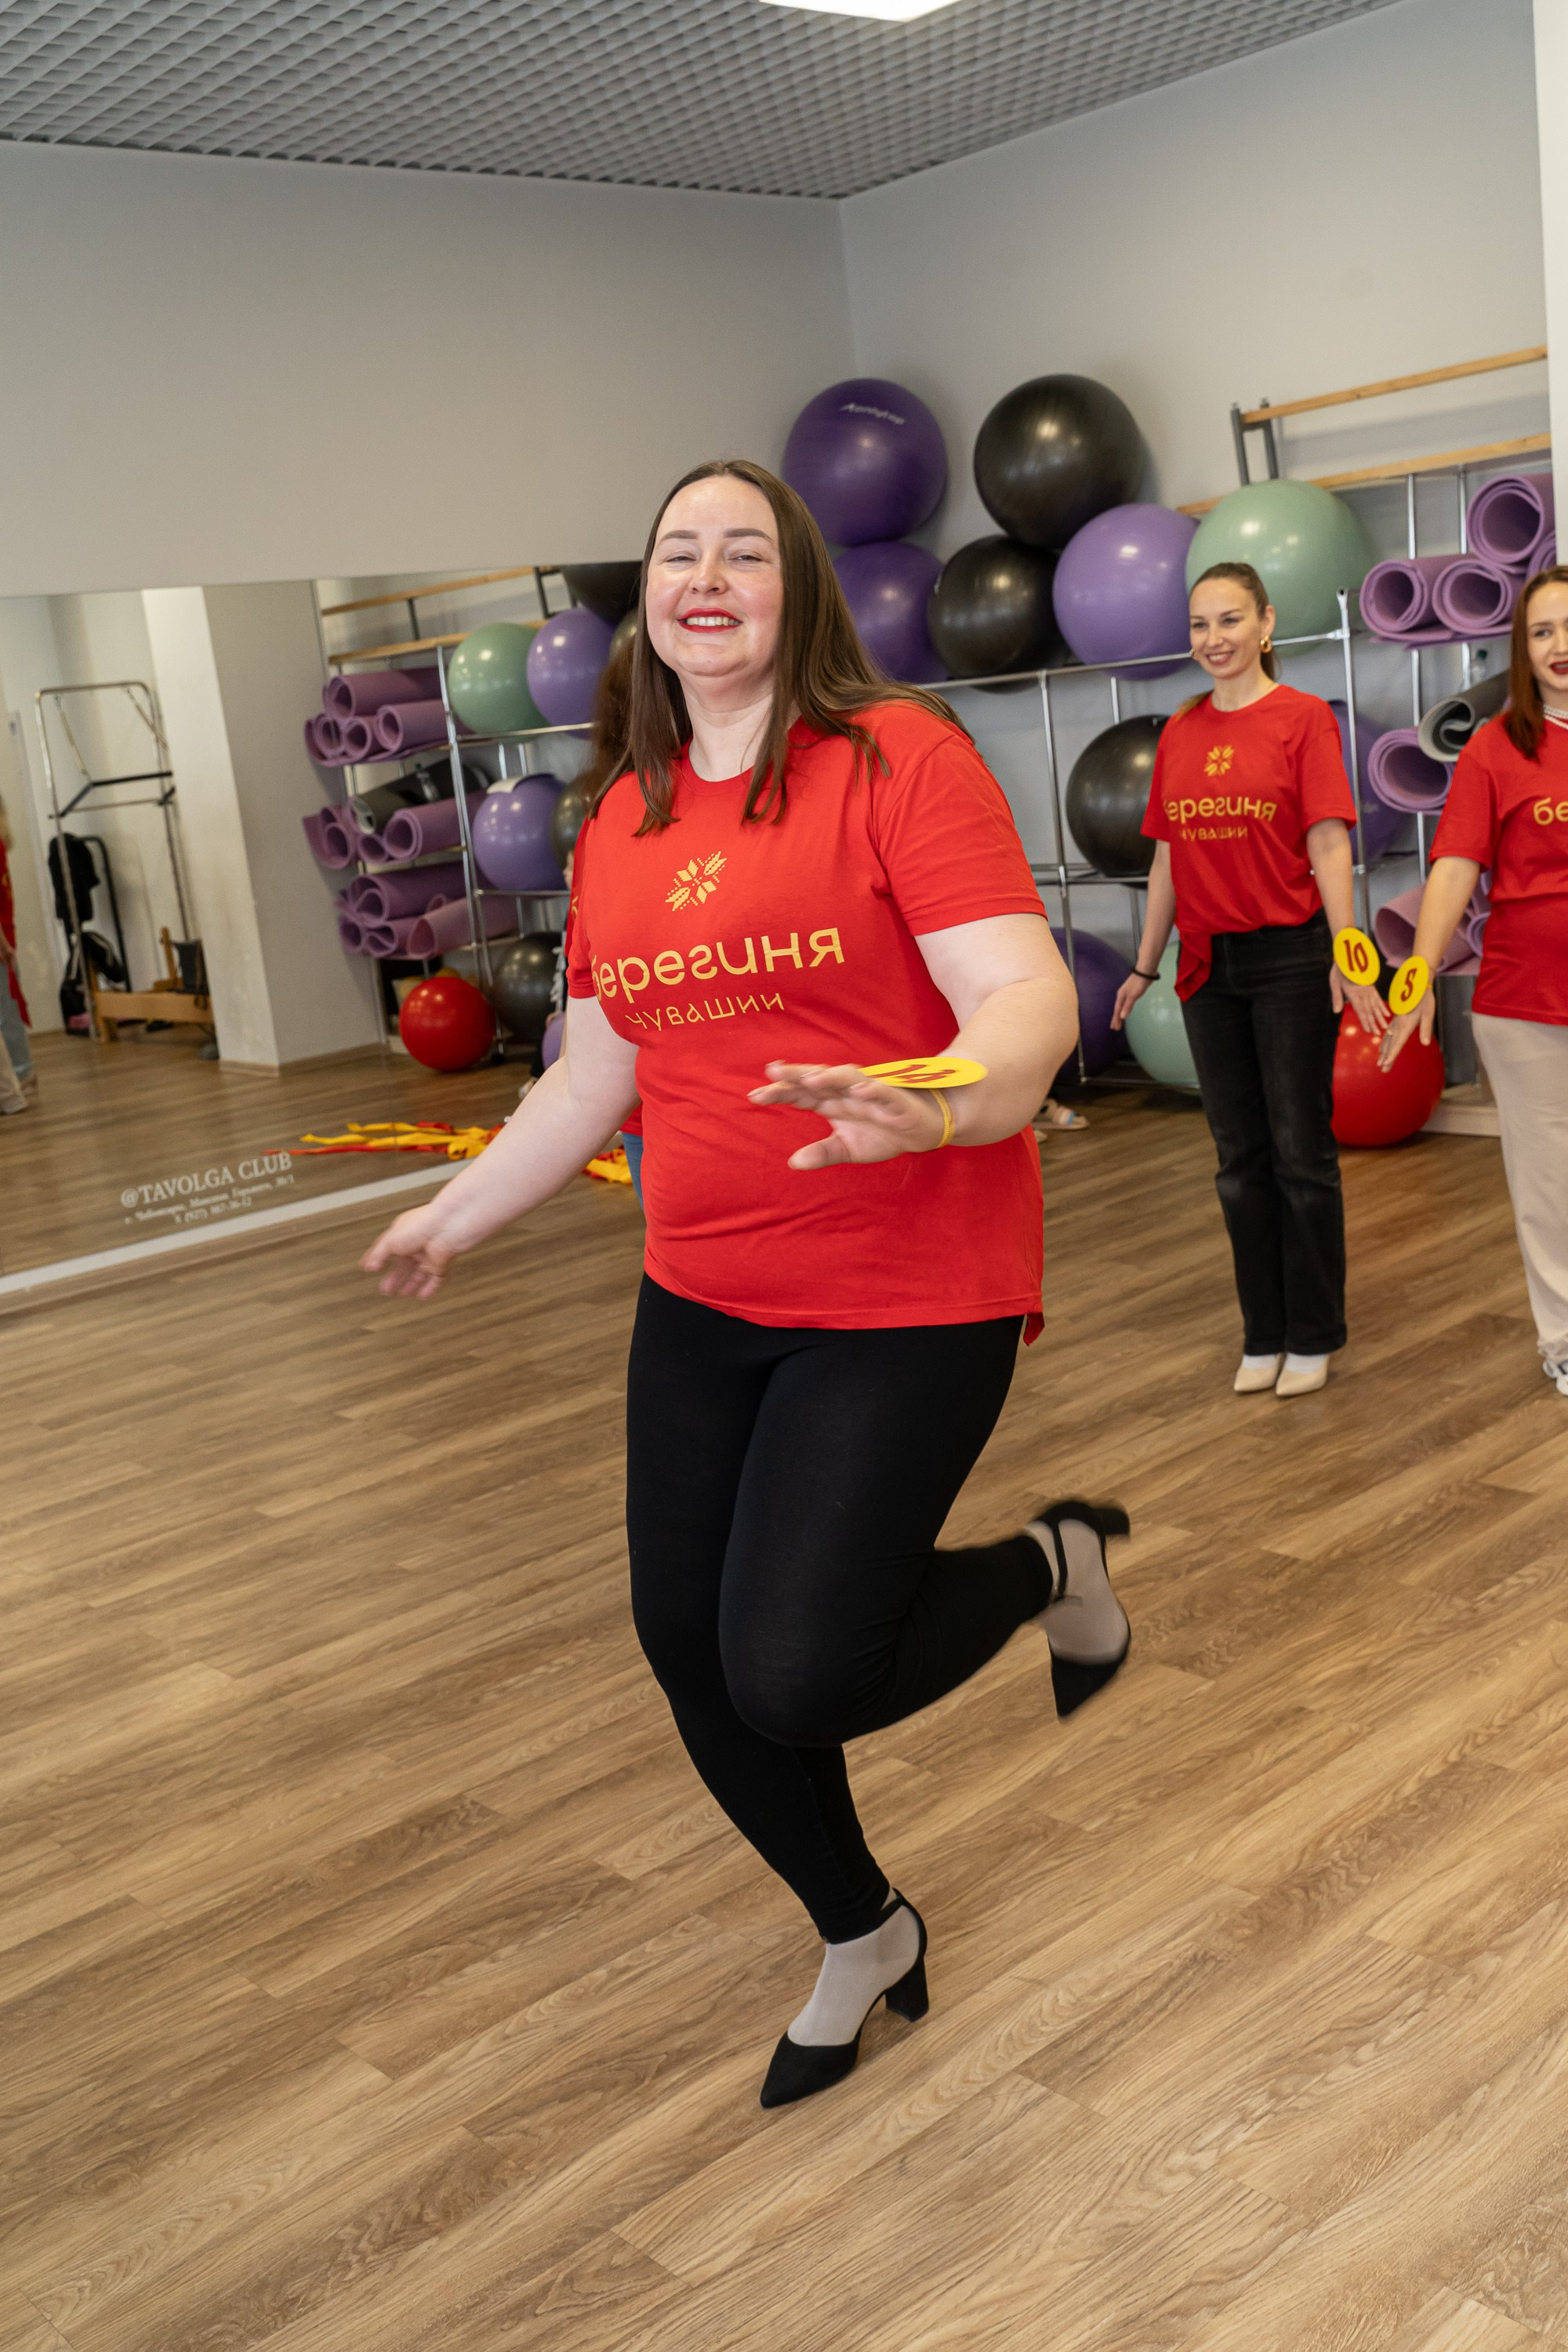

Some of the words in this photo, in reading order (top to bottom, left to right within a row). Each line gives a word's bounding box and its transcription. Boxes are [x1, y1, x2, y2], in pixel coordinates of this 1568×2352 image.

[1343, 938, 1369, 974] 10
[1400, 967, 1417, 1002] 5
[625, 993, 785, 1032] чувашии
[120, 1166, 234, 1208] @TAVOLGA
[238, 1151, 293, 1180] CLUB
